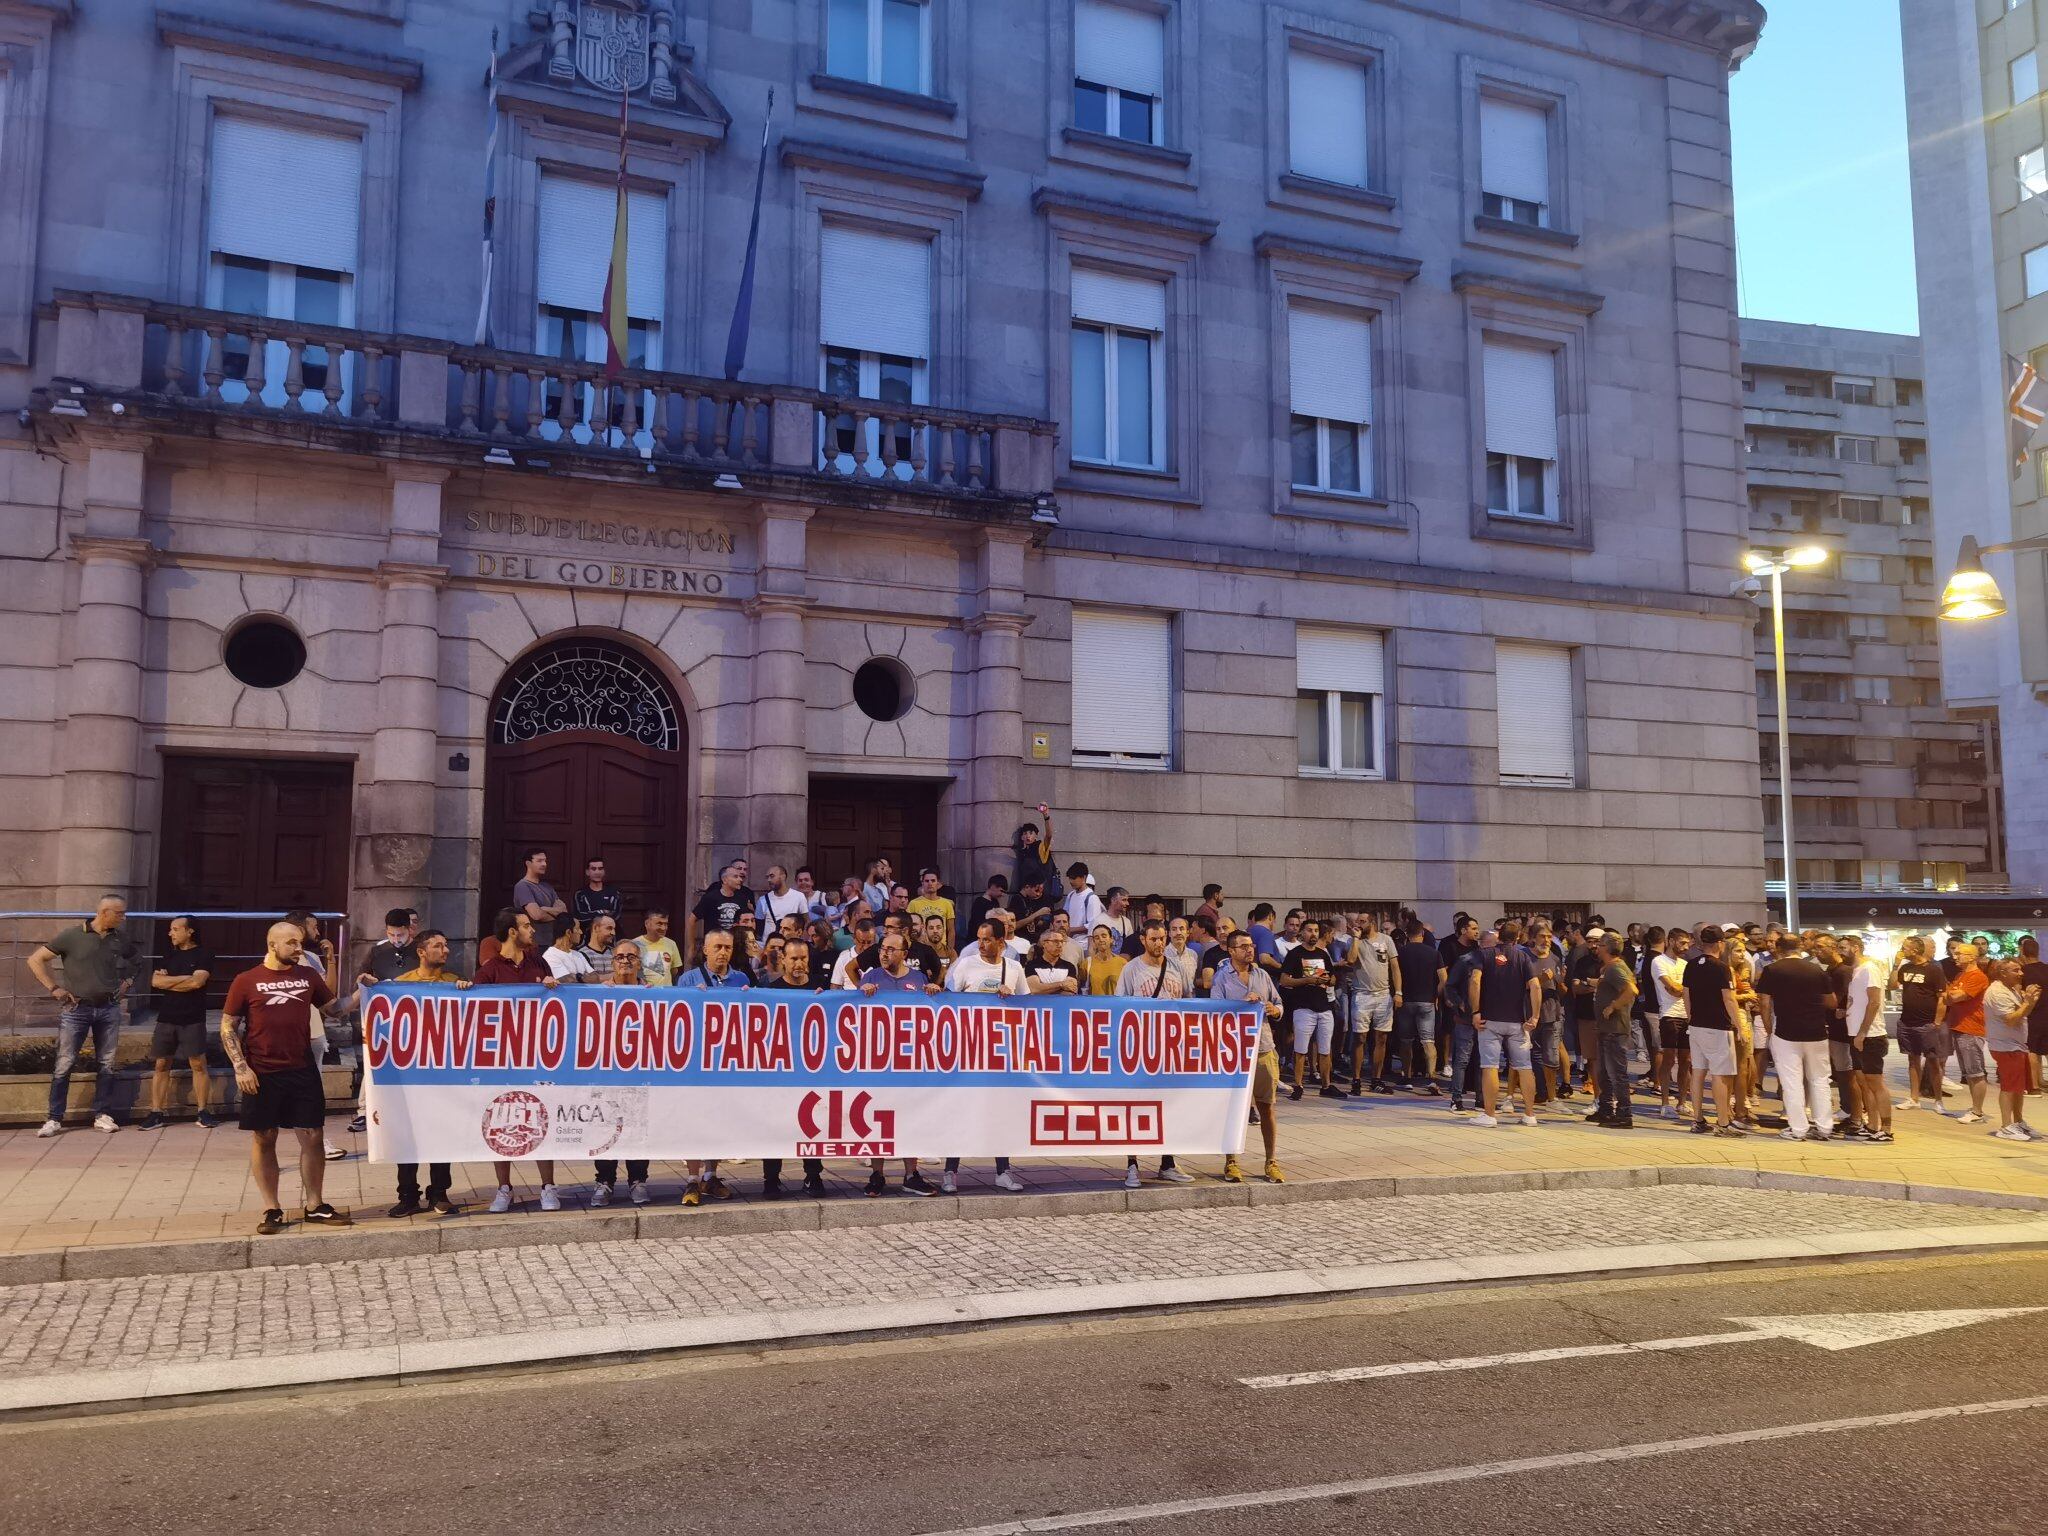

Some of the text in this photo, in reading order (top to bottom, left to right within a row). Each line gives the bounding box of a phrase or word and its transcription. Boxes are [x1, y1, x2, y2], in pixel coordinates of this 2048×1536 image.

[465, 511, 736, 554] SUBDELEGACIÓN
[477, 554, 723, 594] DEL GOBIERNO
[256, 979, 310, 992] Reebok
[364, 994, 1257, 1075] CONVENIO DIGNO PARA O SIDEROMETAL DE OURENSE
[488, 1101, 542, 1129] UGT
[557, 1104, 604, 1122] MCA
[798, 1090, 895, 1139] CIG
[1035, 1105, 1158, 1141] CCOO
[800, 1143, 892, 1156] METAL
